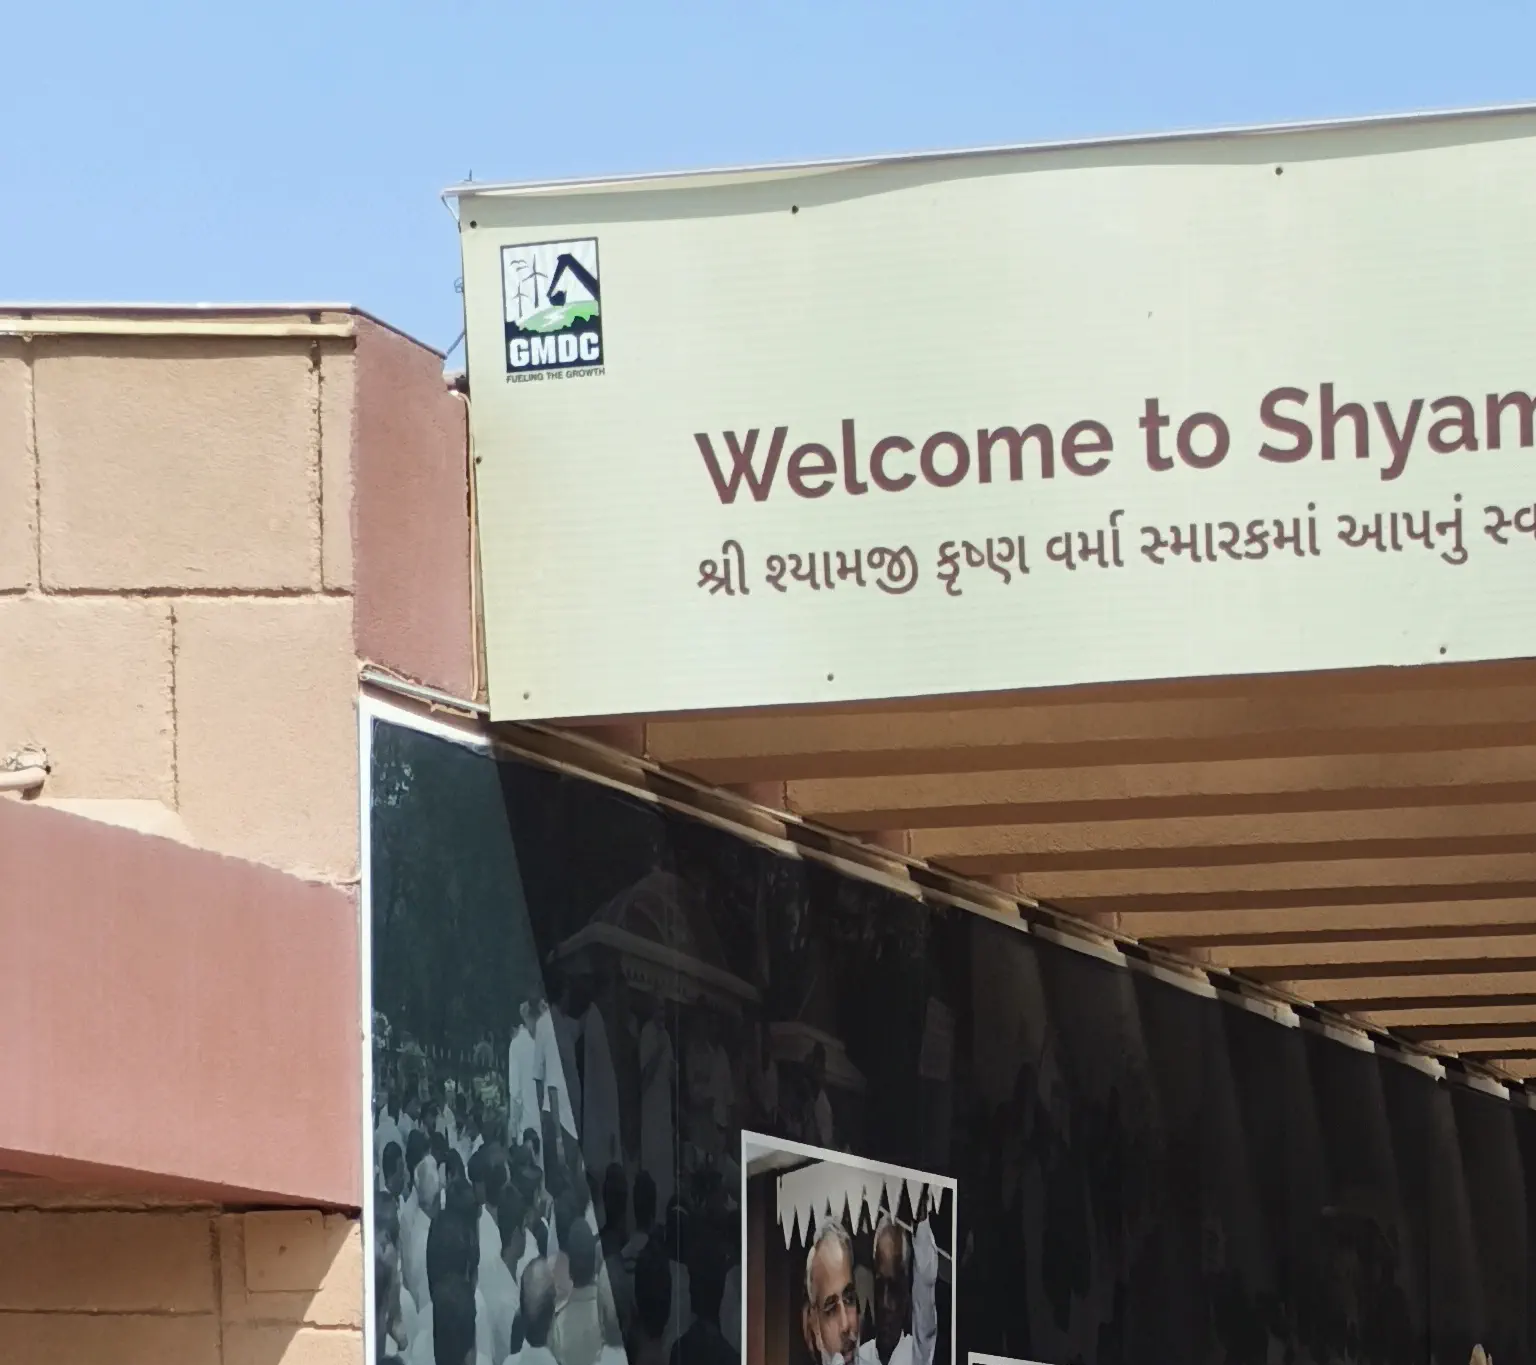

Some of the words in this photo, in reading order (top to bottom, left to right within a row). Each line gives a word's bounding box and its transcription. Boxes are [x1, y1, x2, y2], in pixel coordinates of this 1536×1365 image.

[506, 372, 543, 383] FUELING
[546, 371, 563, 380] THE
[566, 367, 605, 378] GROWTH
[510, 332, 599, 367] GMDC
[694, 419, 1113, 504] Welcome
[1139, 398, 1230, 471] to
[697, 540, 749, 596] શ્રી
[766, 545, 918, 594] શ્યામજી
[937, 537, 1029, 596] કૃષ્ણ
[1046, 510, 1124, 570] વર્મા
[1141, 502, 1320, 564] સ્મારકમાં
[1338, 493, 1468, 565] આપનું
